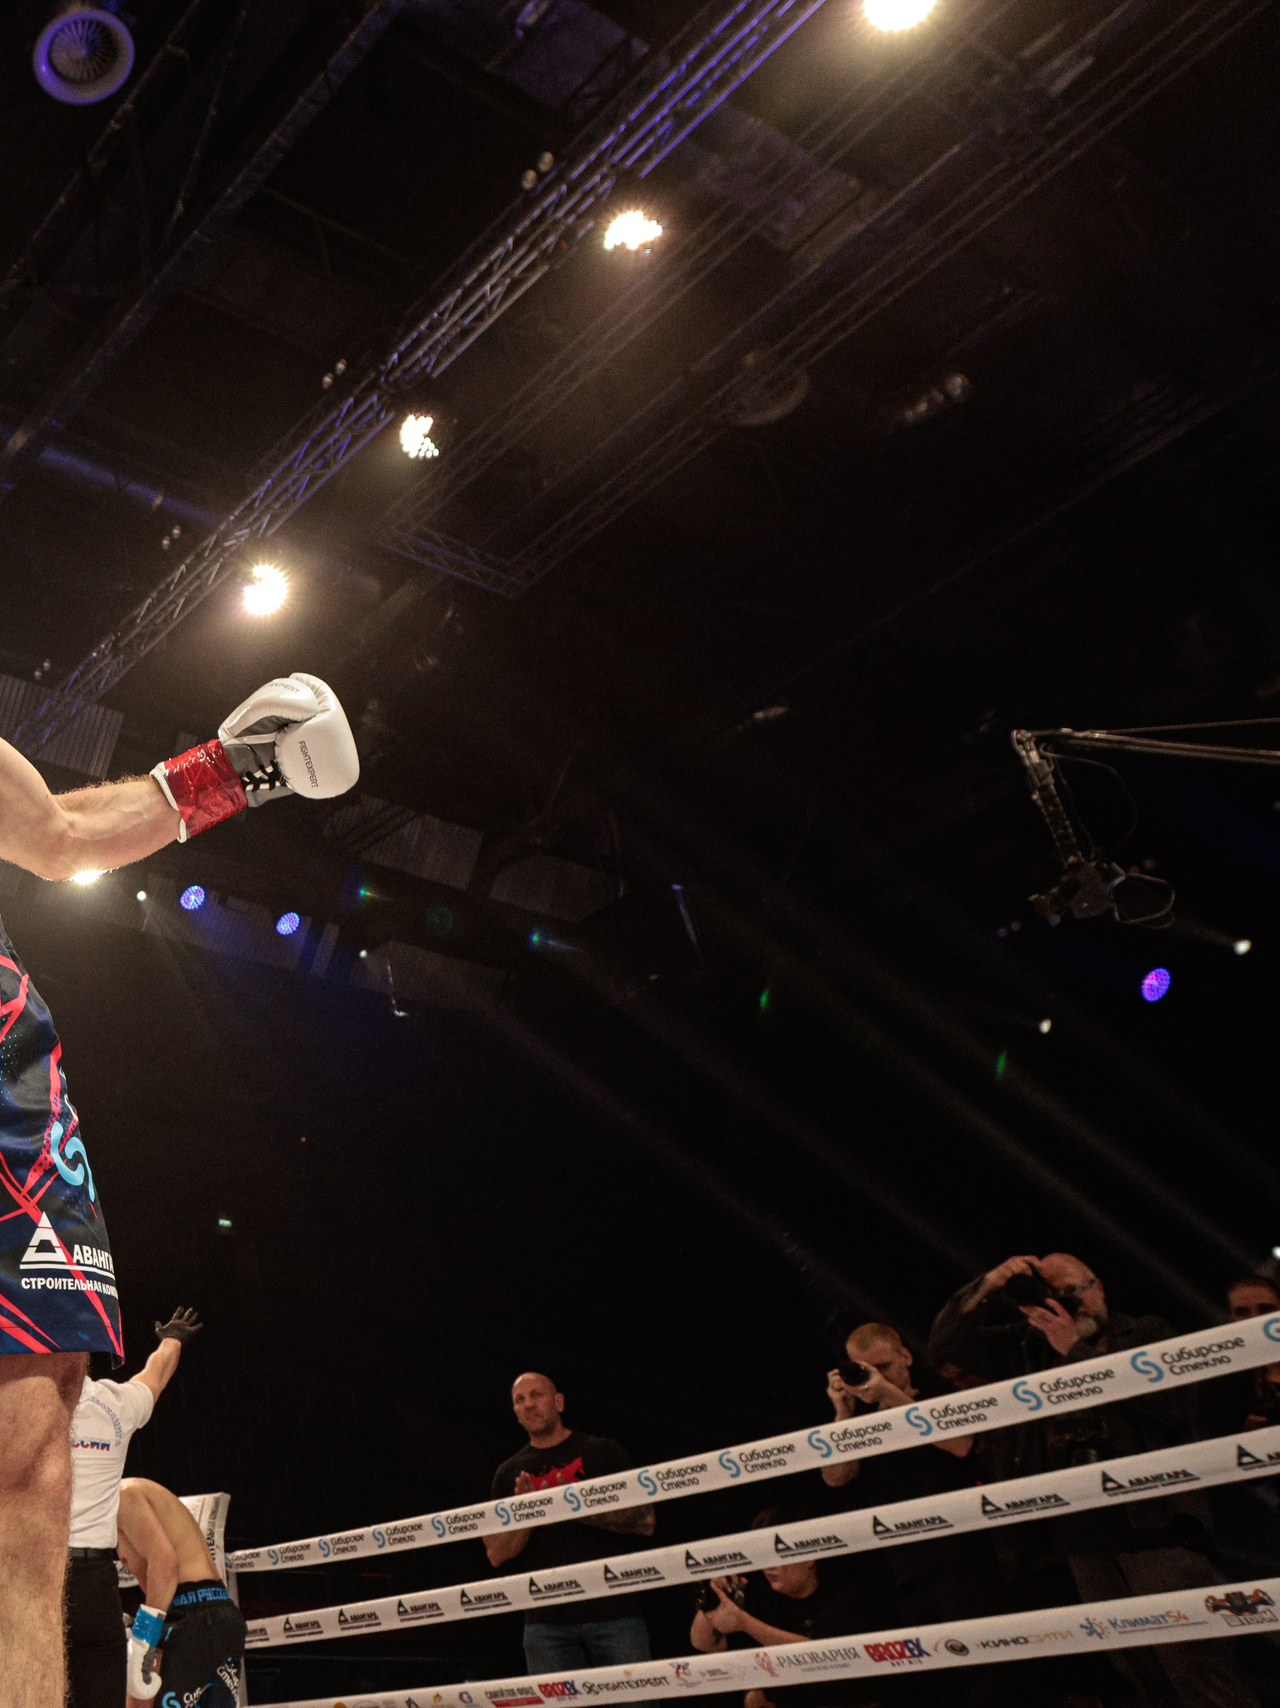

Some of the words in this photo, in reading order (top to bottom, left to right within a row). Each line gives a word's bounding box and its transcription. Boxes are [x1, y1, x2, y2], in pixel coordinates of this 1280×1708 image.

[298, 741, 318, 787] FIGHTEXPERT
[73, 1244, 114, 1274] АВАНГА
[21, 1277, 102, 1293] СТРОИТЕЛЬНАЯ
[1161, 1336, 1246, 1365] Сибирское
[1169, 1353, 1232, 1376] Стекло
[1040, 1368, 1115, 1394] Сибирское
[1048, 1384, 1104, 1405] Стекло
[930, 1396, 998, 1419] Сибирское
[936, 1412, 988, 1430] Стекло
[830, 1421, 892, 1442] Сибирское
[72, 1438, 111, 1451] ССИИ
[836, 1436, 883, 1453] Стекло
[739, 1443, 796, 1464] Сибирское
[656, 1462, 708, 1481] Сибирское
[744, 1458, 787, 1474] Стекло
[660, 1476, 700, 1492] Стекло
[1128, 1469, 1198, 1487] АВАНГАРД
[580, 1480, 627, 1498] Сибирское
[510, 1496, 553, 1513] Сибирское
[583, 1493, 620, 1508] Стекло
[1005, 1493, 1067, 1511] АВАНГАРД
[446, 1510, 486, 1525] Сибирское
[513, 1509, 546, 1523] Стекло
[894, 1515, 949, 1531] АВАНГАРД
[386, 1522, 423, 1536] Сибирское
[448, 1522, 479, 1535] Стекло
[388, 1534, 416, 1546] Стекло
[794, 1534, 843, 1549] АВАНГАРД
[703, 1551, 748, 1565] АВАНГАРД
[620, 1566, 661, 1578] АВАНГАРД
[543, 1579, 582, 1591] АВАНГАРД
[473, 1591, 509, 1602] АВАНГАРД
[409, 1602, 442, 1613] АВАНГАРД
[1108, 1611, 1189, 1630] Климат54
[980, 1630, 1074, 1649] КИНОСИТИ
[597, 1676, 670, 1693] FIGHTEXPERT
